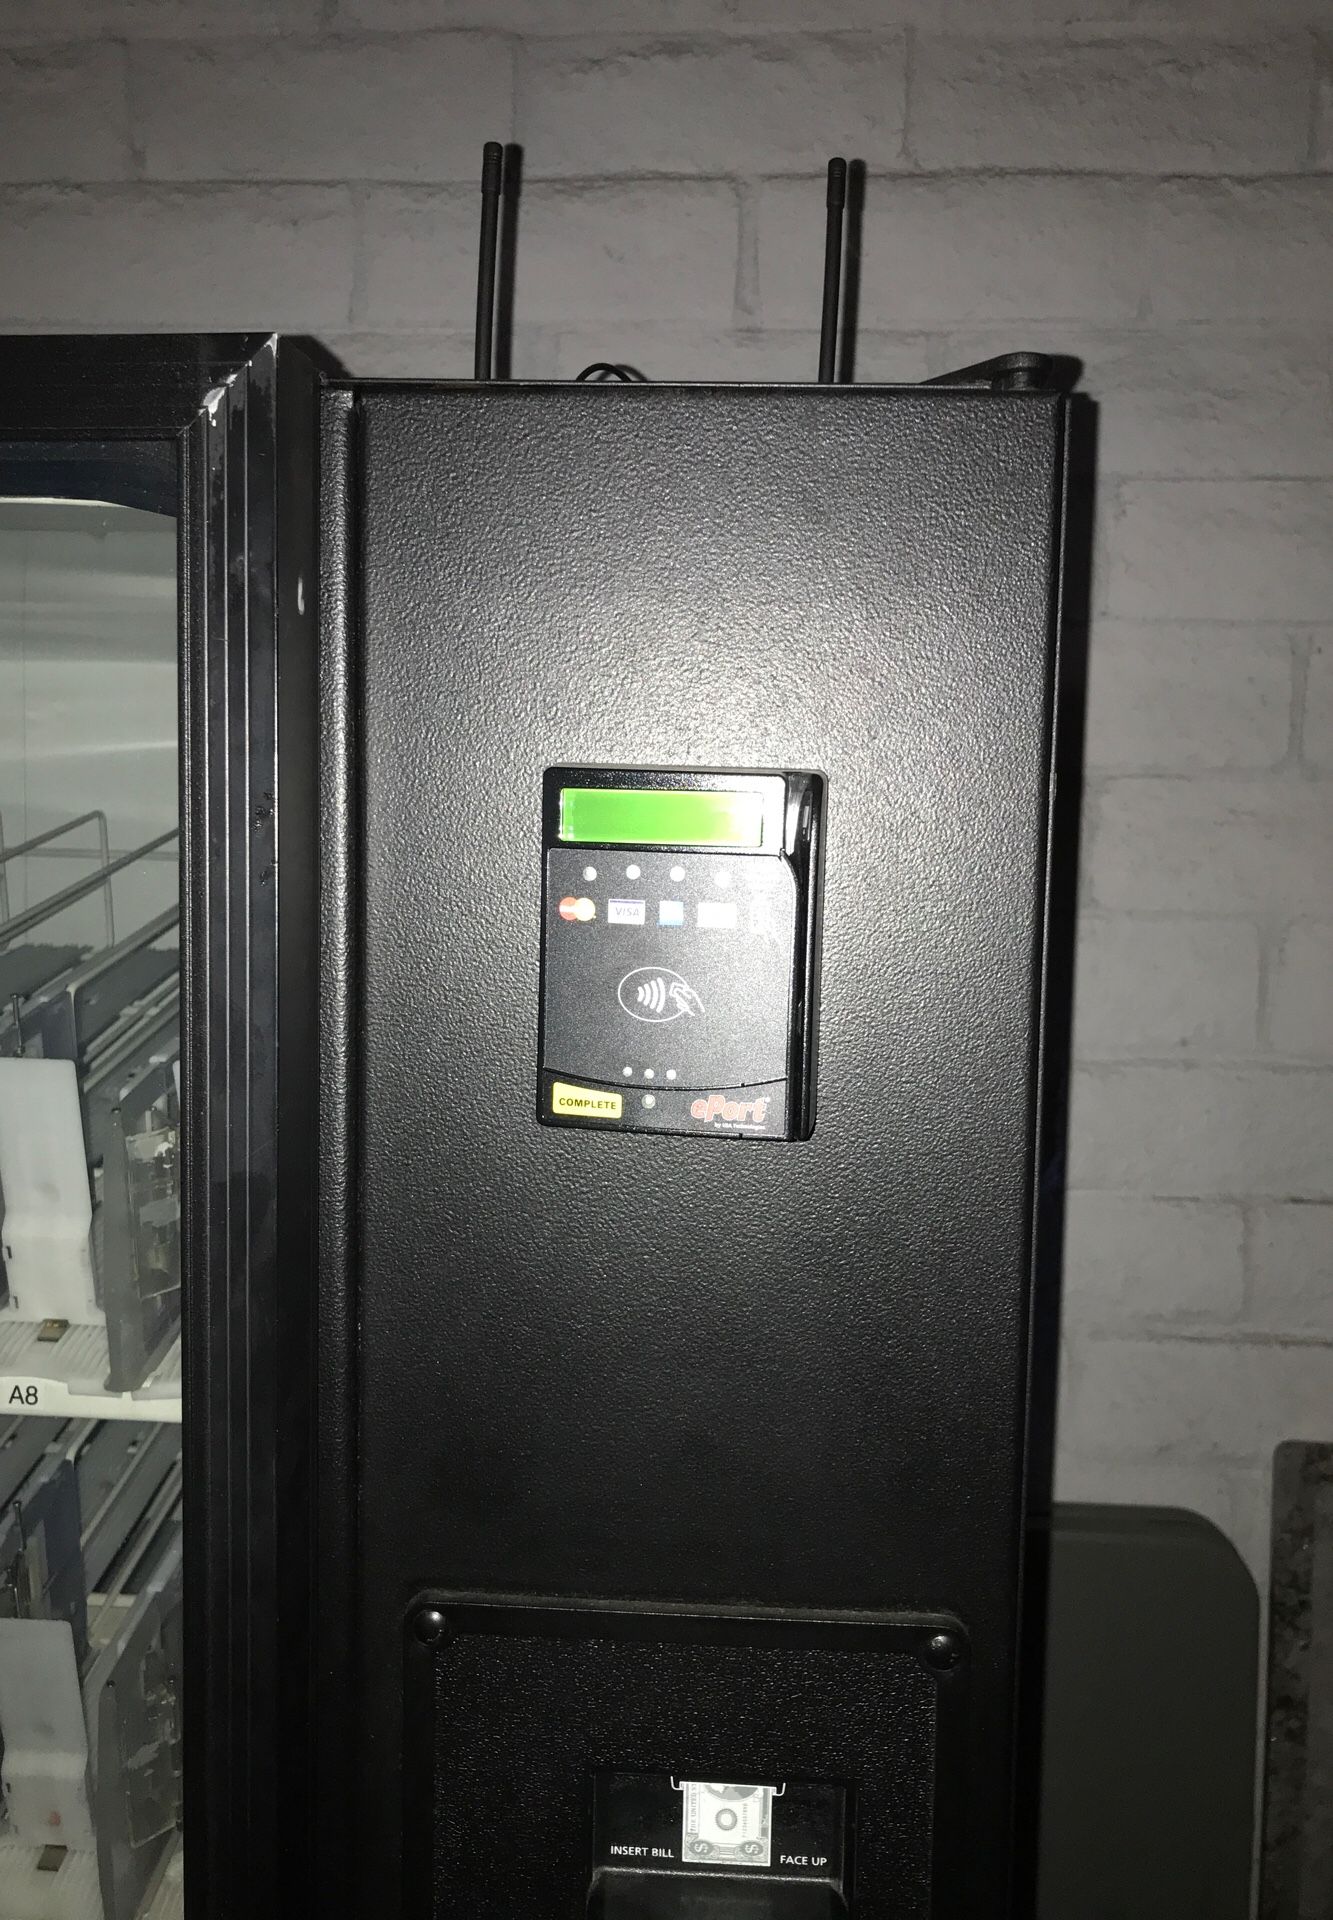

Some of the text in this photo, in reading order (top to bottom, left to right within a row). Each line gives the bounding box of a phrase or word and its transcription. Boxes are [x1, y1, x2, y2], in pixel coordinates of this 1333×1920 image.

[615, 907, 640, 916] VISA
[559, 1097, 617, 1110] COMPLETE
[691, 1094, 767, 1123] ePort
[8, 1384, 39, 1406] A8
[610, 1845, 675, 1858] INSERT BILL
[780, 1854, 828, 1866] FACE UP
